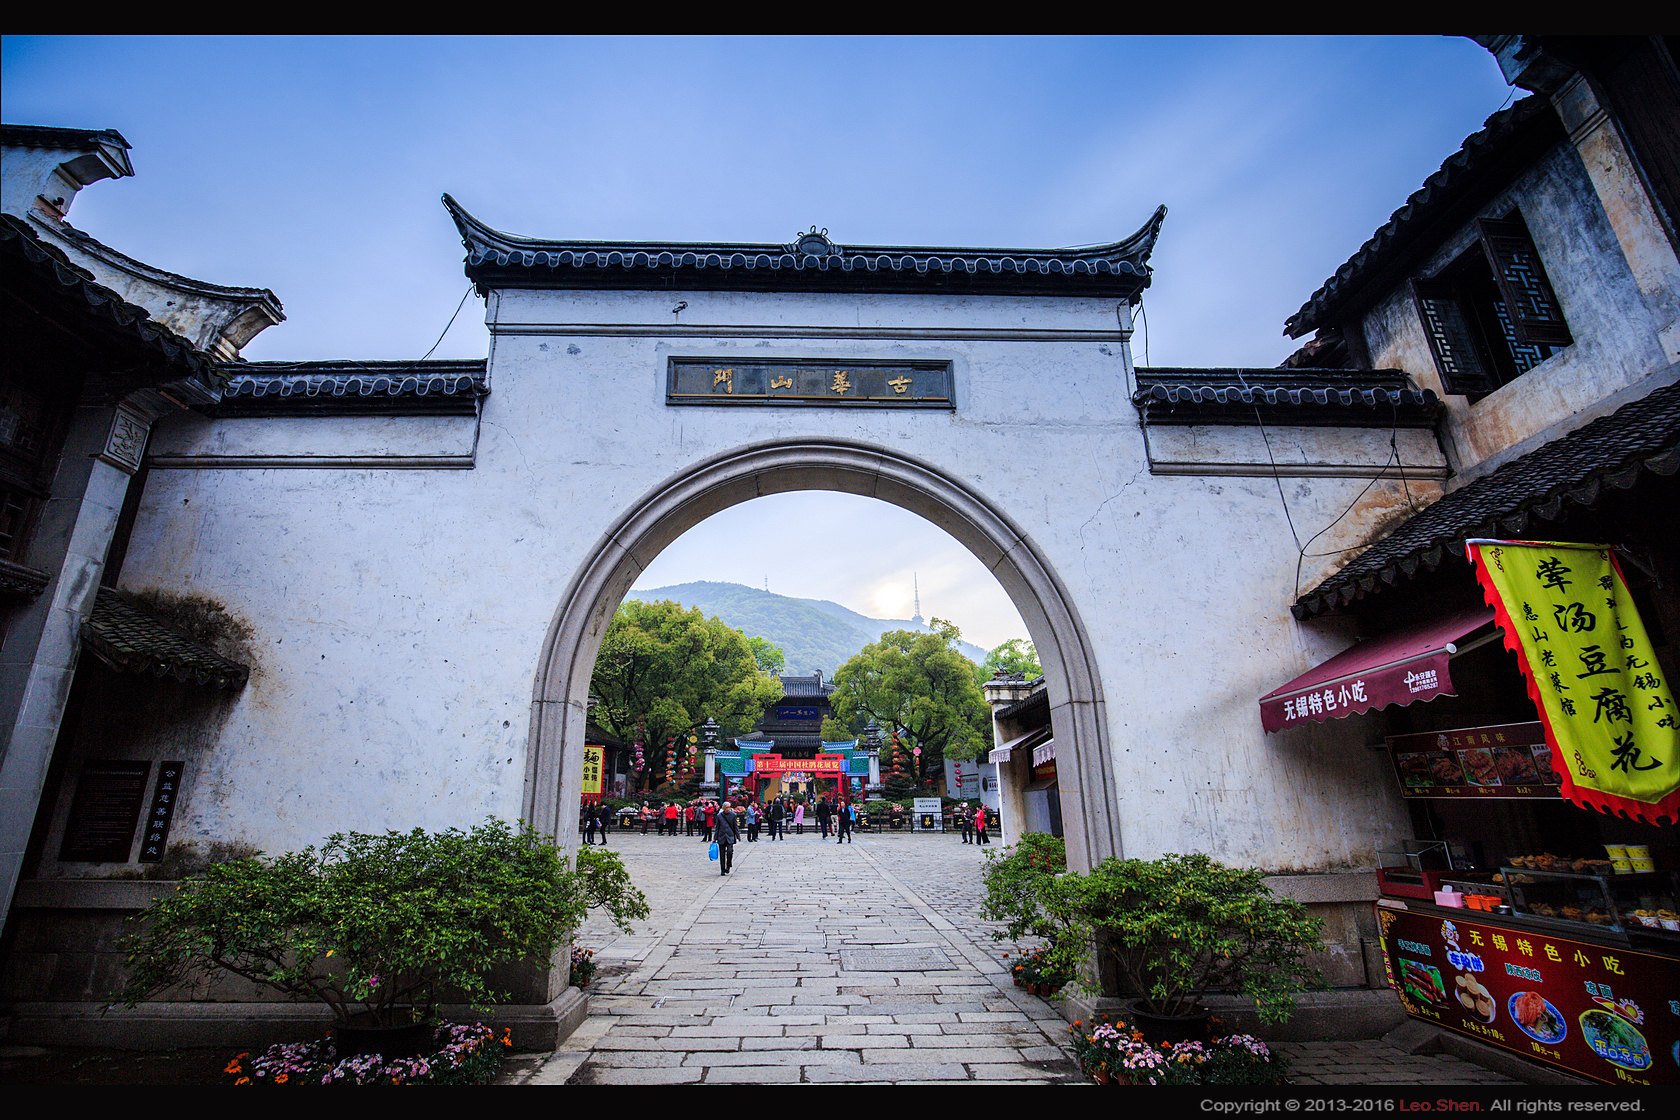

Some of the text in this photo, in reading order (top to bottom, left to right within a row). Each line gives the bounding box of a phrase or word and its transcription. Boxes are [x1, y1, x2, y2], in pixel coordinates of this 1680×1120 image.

[1523, 602, 1577, 717] 惠山老菜馆
[1536, 556, 1663, 773] 荤汤豆腐花
[1284, 680, 1368, 722] 无锡特色小吃
[1449, 952, 1483, 971] 车轮饼
[1469, 930, 1625, 976] 无锡特色小吃
[1504, 962, 1543, 983] 陕西凉皮
[1583, 980, 1614, 1000] 凉面
[1594, 1039, 1645, 1066] 爽口凉面
